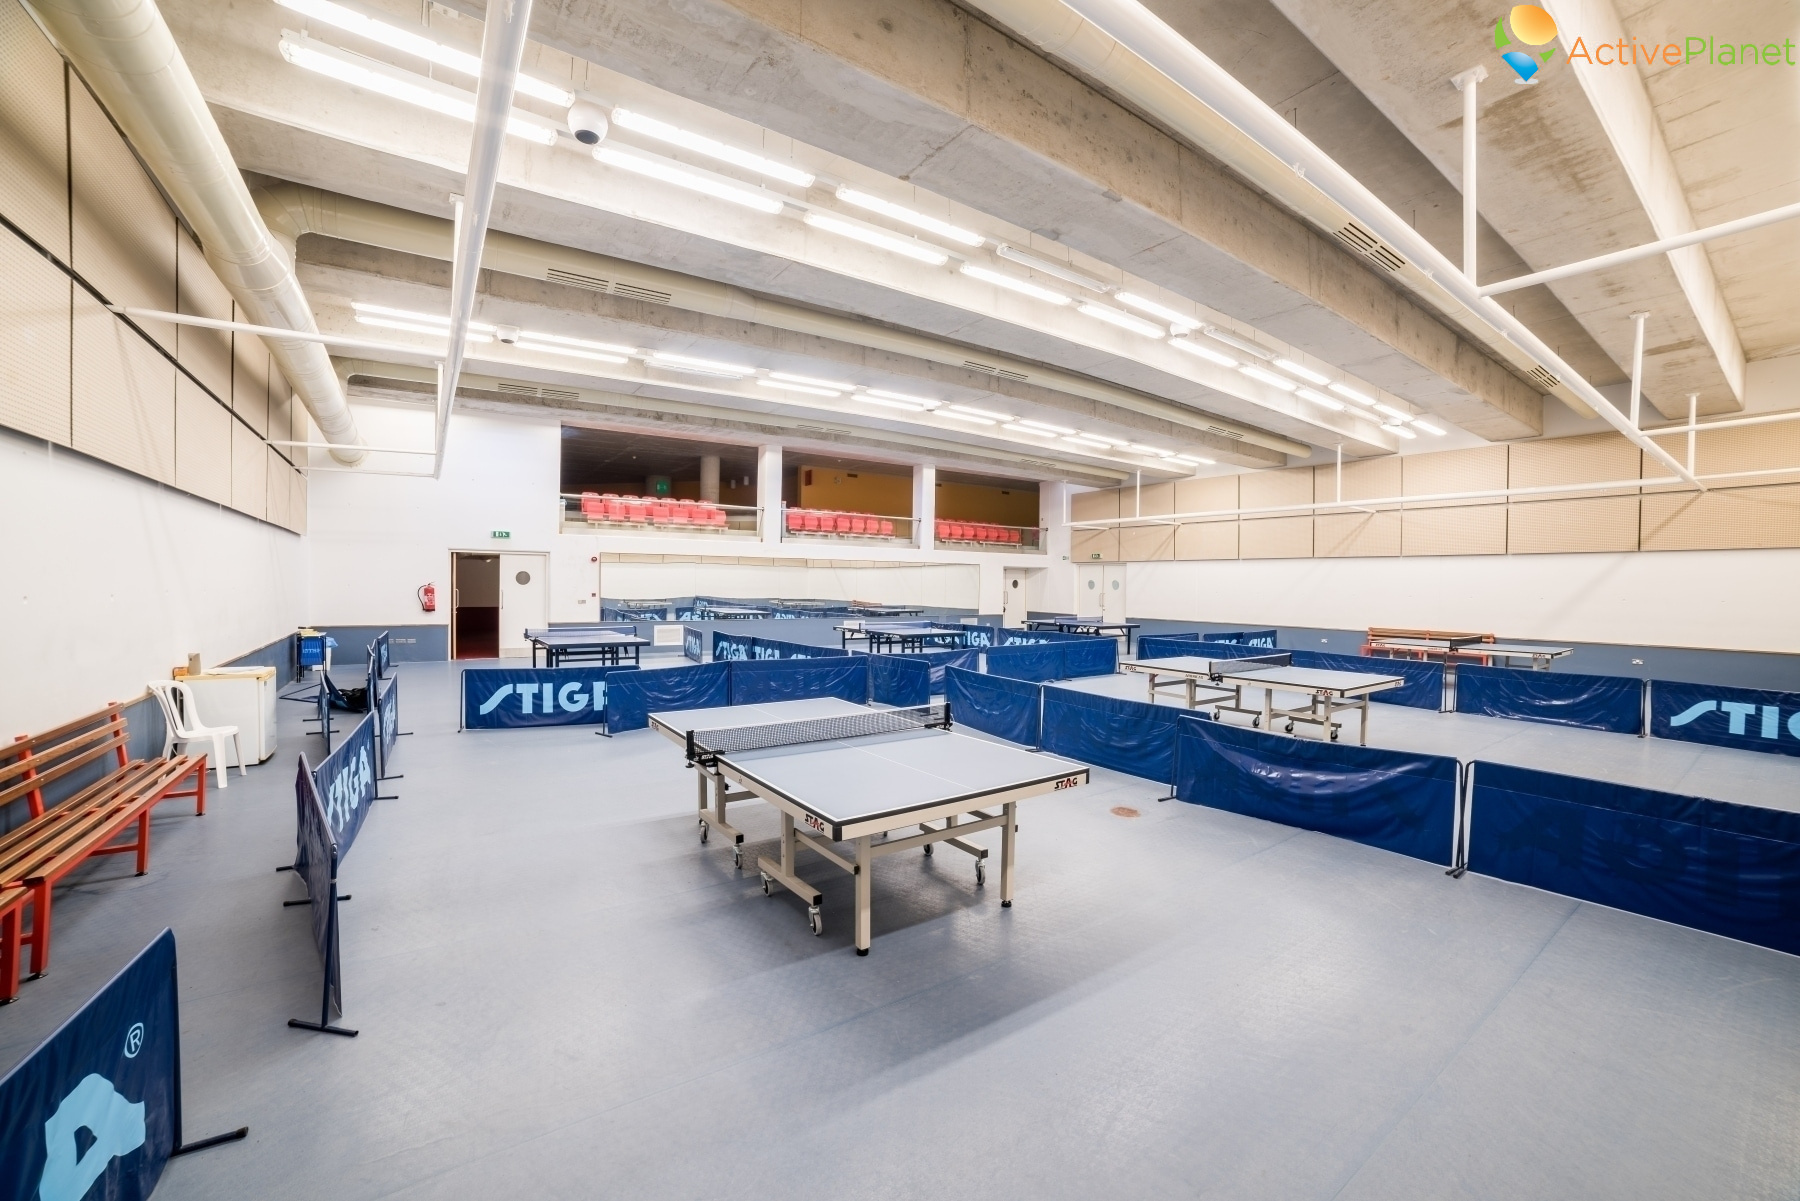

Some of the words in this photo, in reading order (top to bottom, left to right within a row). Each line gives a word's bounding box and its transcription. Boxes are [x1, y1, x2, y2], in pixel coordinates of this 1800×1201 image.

[715, 640, 748, 660] STIGA
[327, 745, 371, 833] STIGA
[1054, 777, 1078, 790] STAG
[804, 813, 825, 833] STAG
